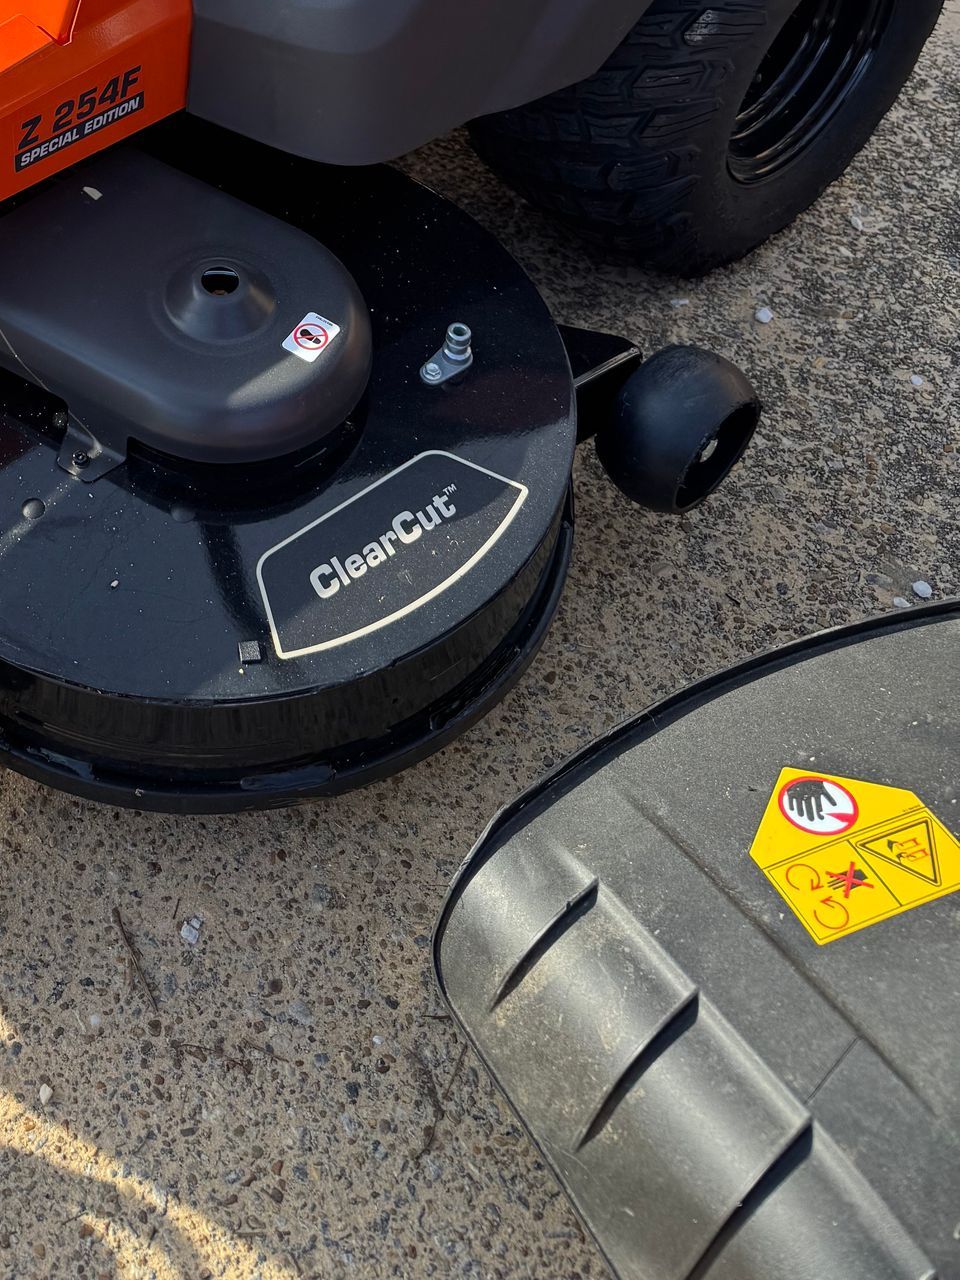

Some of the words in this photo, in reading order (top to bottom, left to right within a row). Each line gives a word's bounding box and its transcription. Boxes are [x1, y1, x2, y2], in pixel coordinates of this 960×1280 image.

[18, 114, 42, 150] Z
[52, 65, 142, 133] 254F
[20, 128, 80, 166] SPECIAL
[84, 97, 140, 134] EDITION
